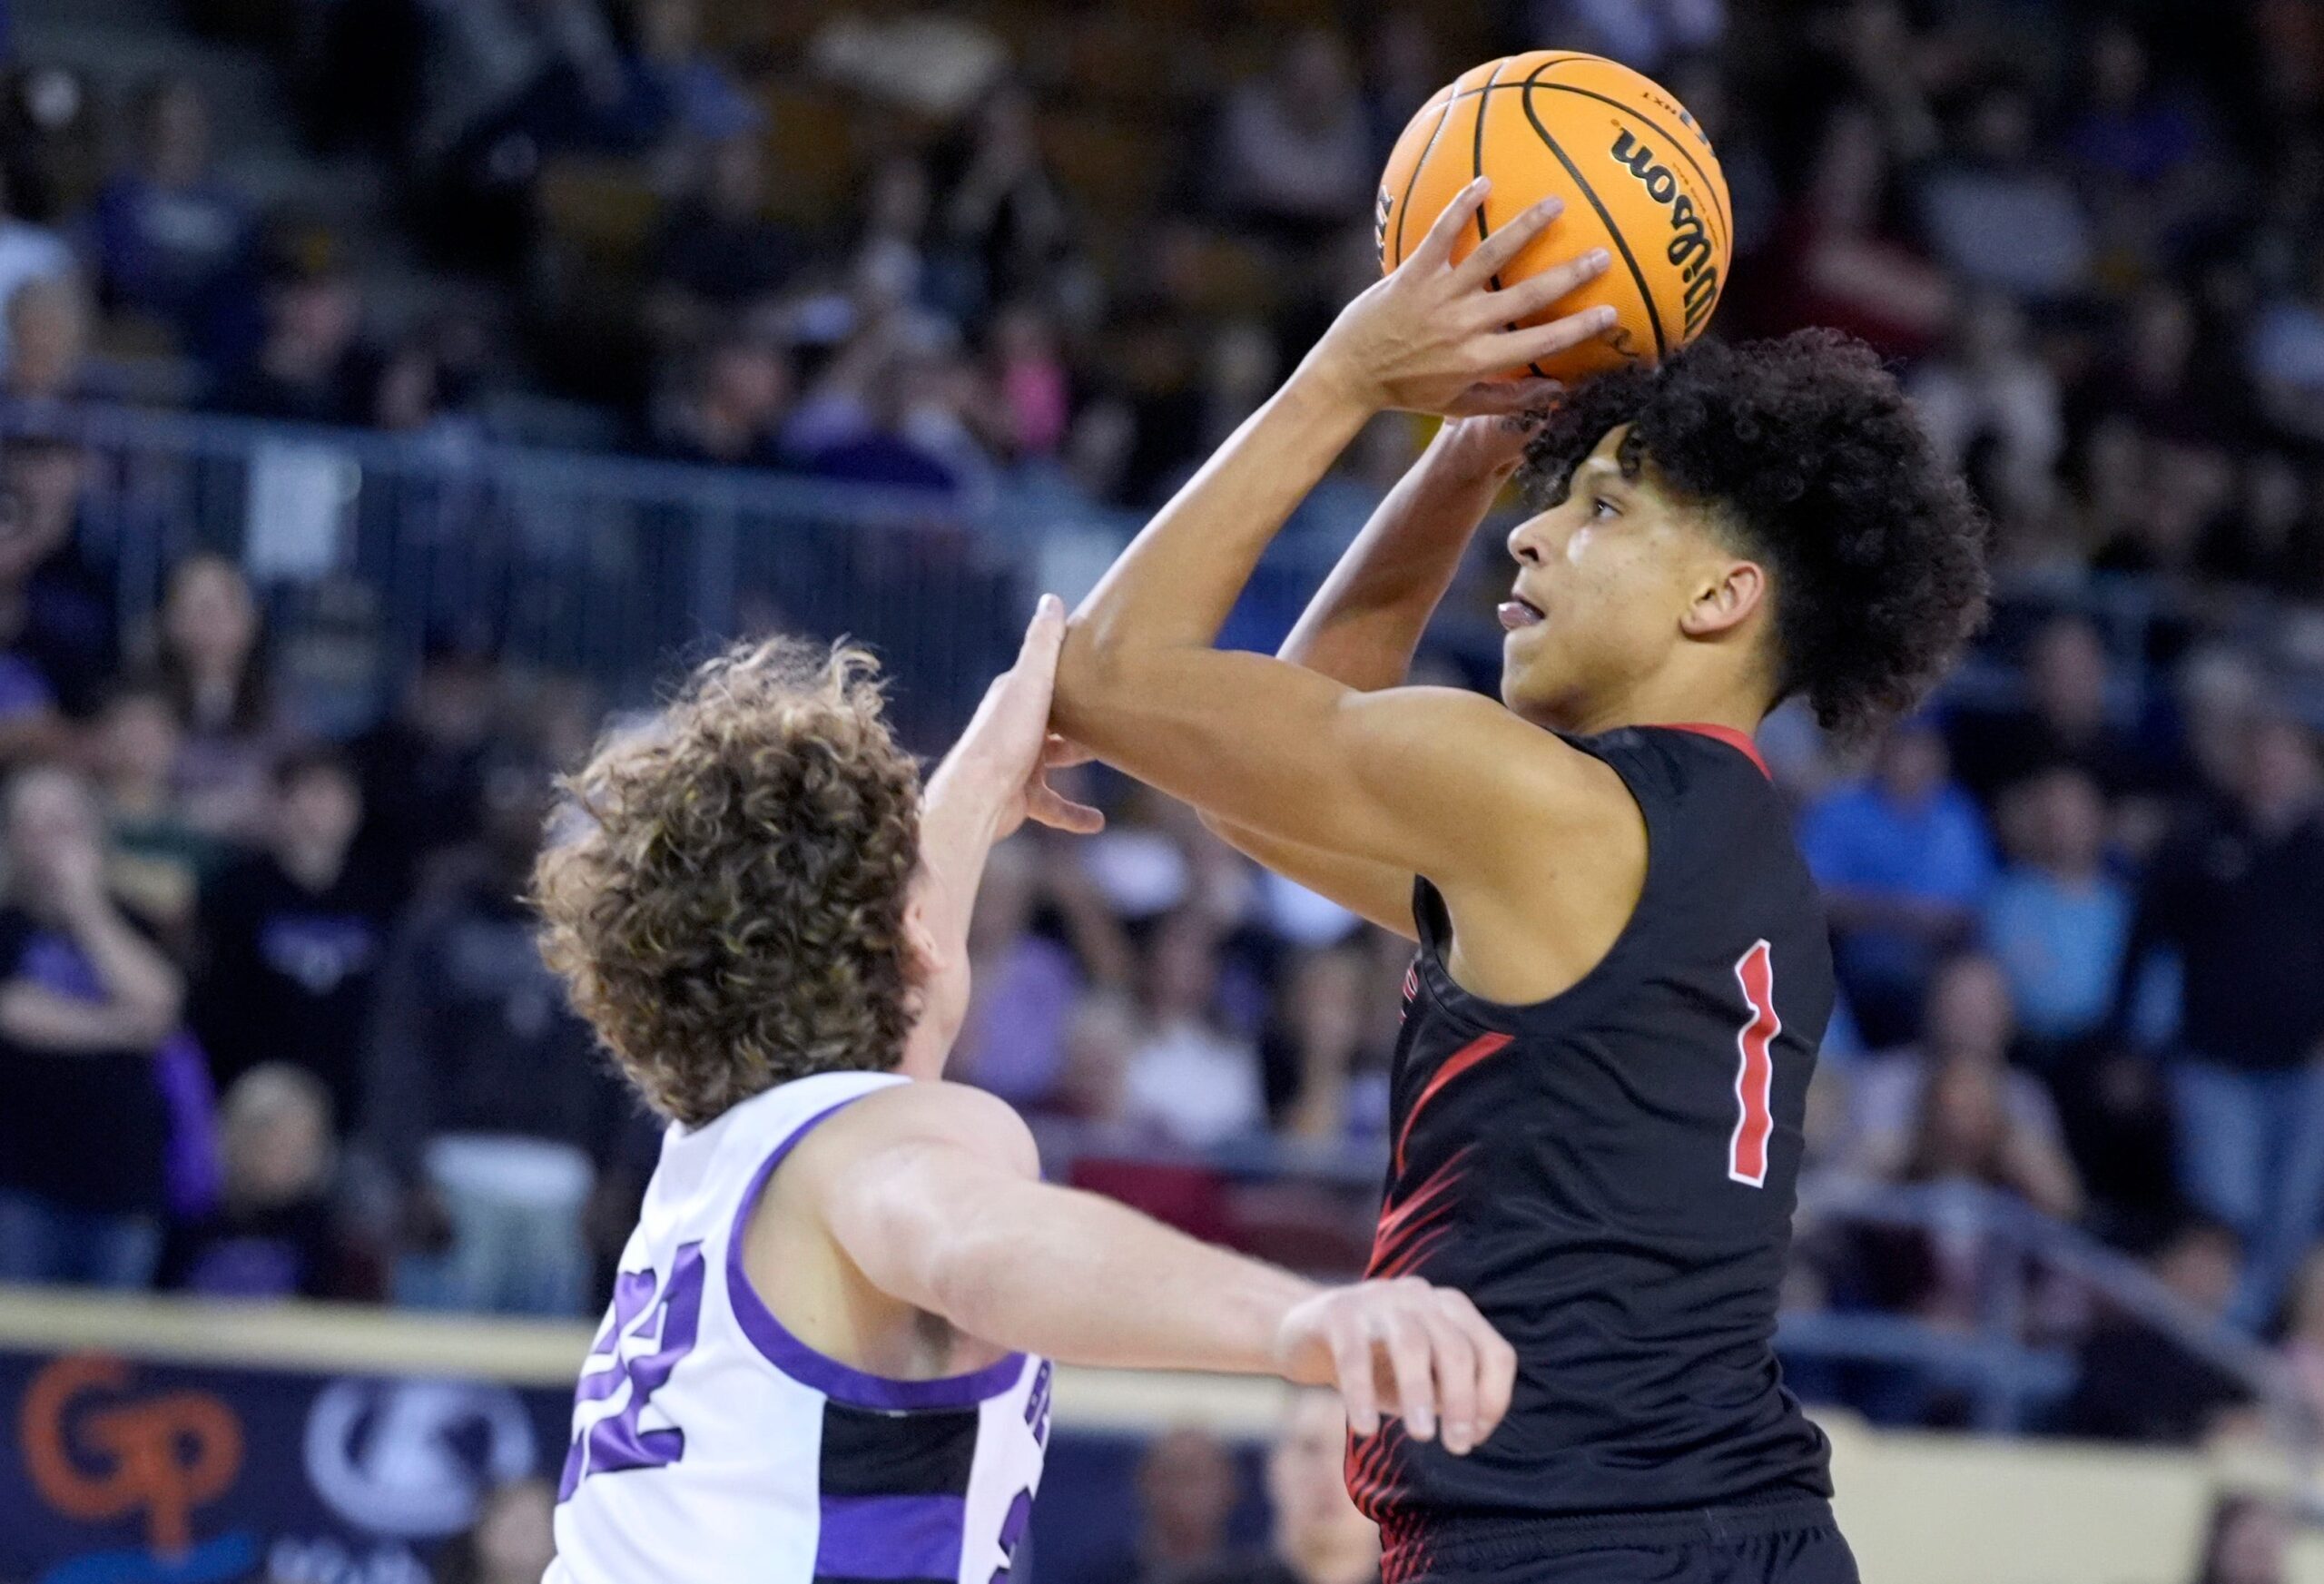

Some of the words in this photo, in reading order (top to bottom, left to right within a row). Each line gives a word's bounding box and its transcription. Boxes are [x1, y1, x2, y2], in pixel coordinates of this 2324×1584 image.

[1640, 92, 1678, 115] NXT
[1610, 127, 1718, 341] Wilson
[1728, 938, 1782, 1189] 1
